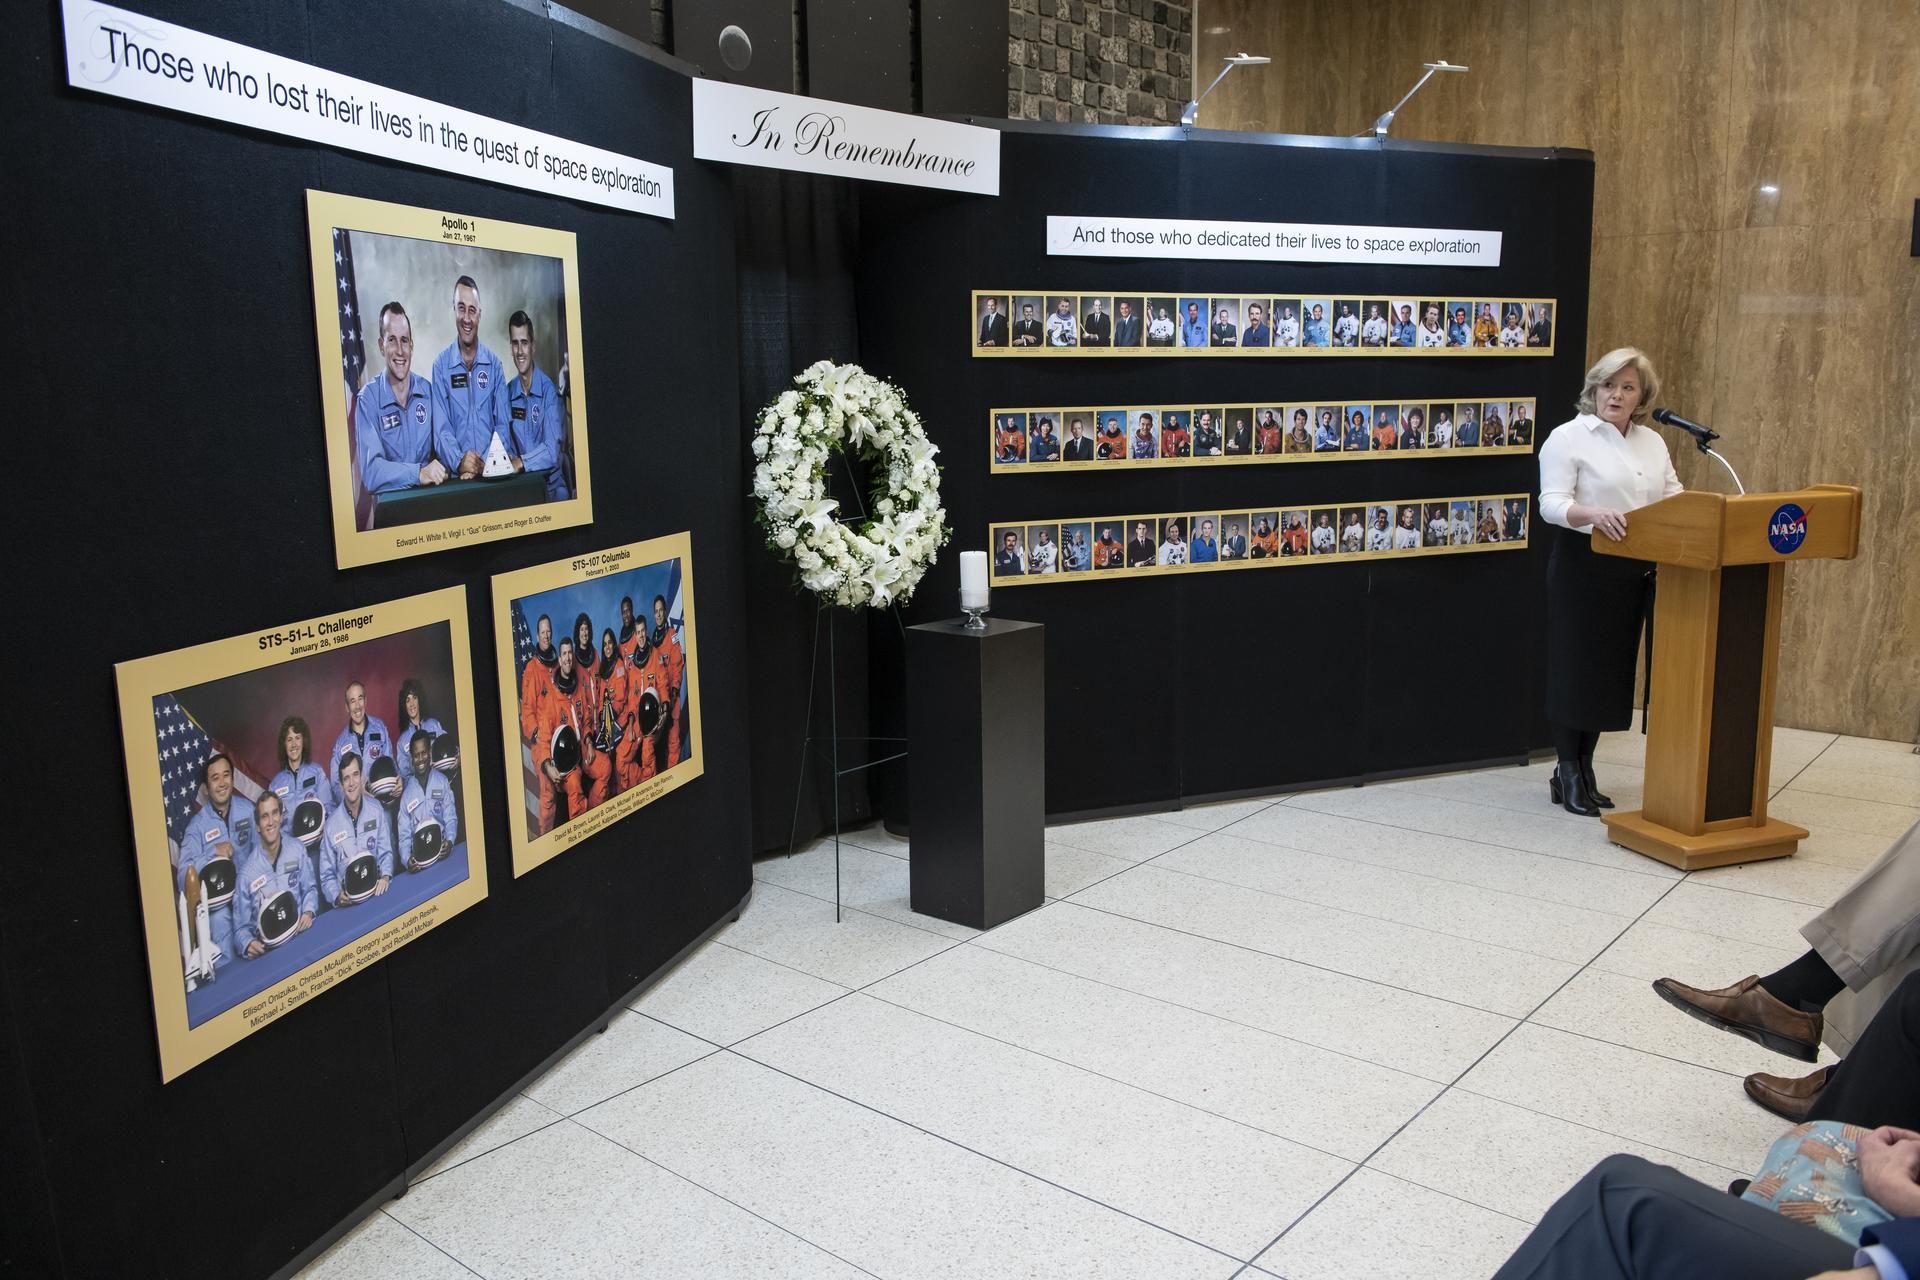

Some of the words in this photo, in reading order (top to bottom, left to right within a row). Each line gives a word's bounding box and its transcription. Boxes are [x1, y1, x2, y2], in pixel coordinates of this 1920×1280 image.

[100, 26, 194, 83] Those
[203, 61, 258, 99] who
[267, 73, 310, 113] lost
[316, 88, 363, 126] their
[370, 101, 412, 138] lives
[418, 115, 435, 144] in
[440, 122, 468, 152] the
[474, 136, 519, 163] quest
[524, 146, 539, 169] of
[544, 155, 587, 180] space
[591, 166, 661, 198] exploration
[732, 106, 784, 152] In
[794, 112, 976, 177] Remembrance
[441, 216, 468, 231] Apollo
[470, 221, 475, 231] 1
[443, 231, 453, 239] Jan
[464, 234, 476, 243] 1967
[1073, 226, 1105, 243] And
[1111, 227, 1155, 244] those
[1160, 229, 1192, 245] who
[1197, 230, 1271, 247] dedicated
[1276, 232, 1307, 248] their
[1311, 233, 1341, 249] lives
[1346, 235, 1359, 250] to
[1364, 239, 1405, 254] space
[1409, 237, 1480, 255] exploration
[396, 537, 418, 547] Edward
[419, 535, 425, 544] H.
[426, 533, 441, 542] White
[448, 529, 461, 539] Virgil
[504, 521, 513, 529] and
[514, 518, 528, 528] Roger
[1770, 522, 1805, 536] NASA
[572, 556, 600, 571] STS-107
[601, 549, 631, 564] Columbia
[586, 568, 604, 577] February
[258, 626, 315, 650] STS-51-L
[318, 614, 374, 635] Challenger
[290, 641, 319, 655] January
[320, 638, 331, 648] 28,
[333, 633, 350, 645] 1986
[242, 1000, 267, 1019] Ellison
[268, 984, 298, 1005] Onizuka,
[299, 969, 323, 987] Christa
[356, 937, 380, 955] Gregory
[381, 927, 400, 941] Jarvis,
[401, 915, 418, 930] Judith
[250, 1006, 278, 1028] Michael
[280, 1002, 286, 1011] J.
[287, 990, 309, 1006] Smith,
[310, 976, 334, 993] Francis
[356, 949, 380, 967] Scobee,
[381, 941, 393, 953] and
[394, 929, 414, 946] Ronald
[414, 918, 434, 934] McNair
